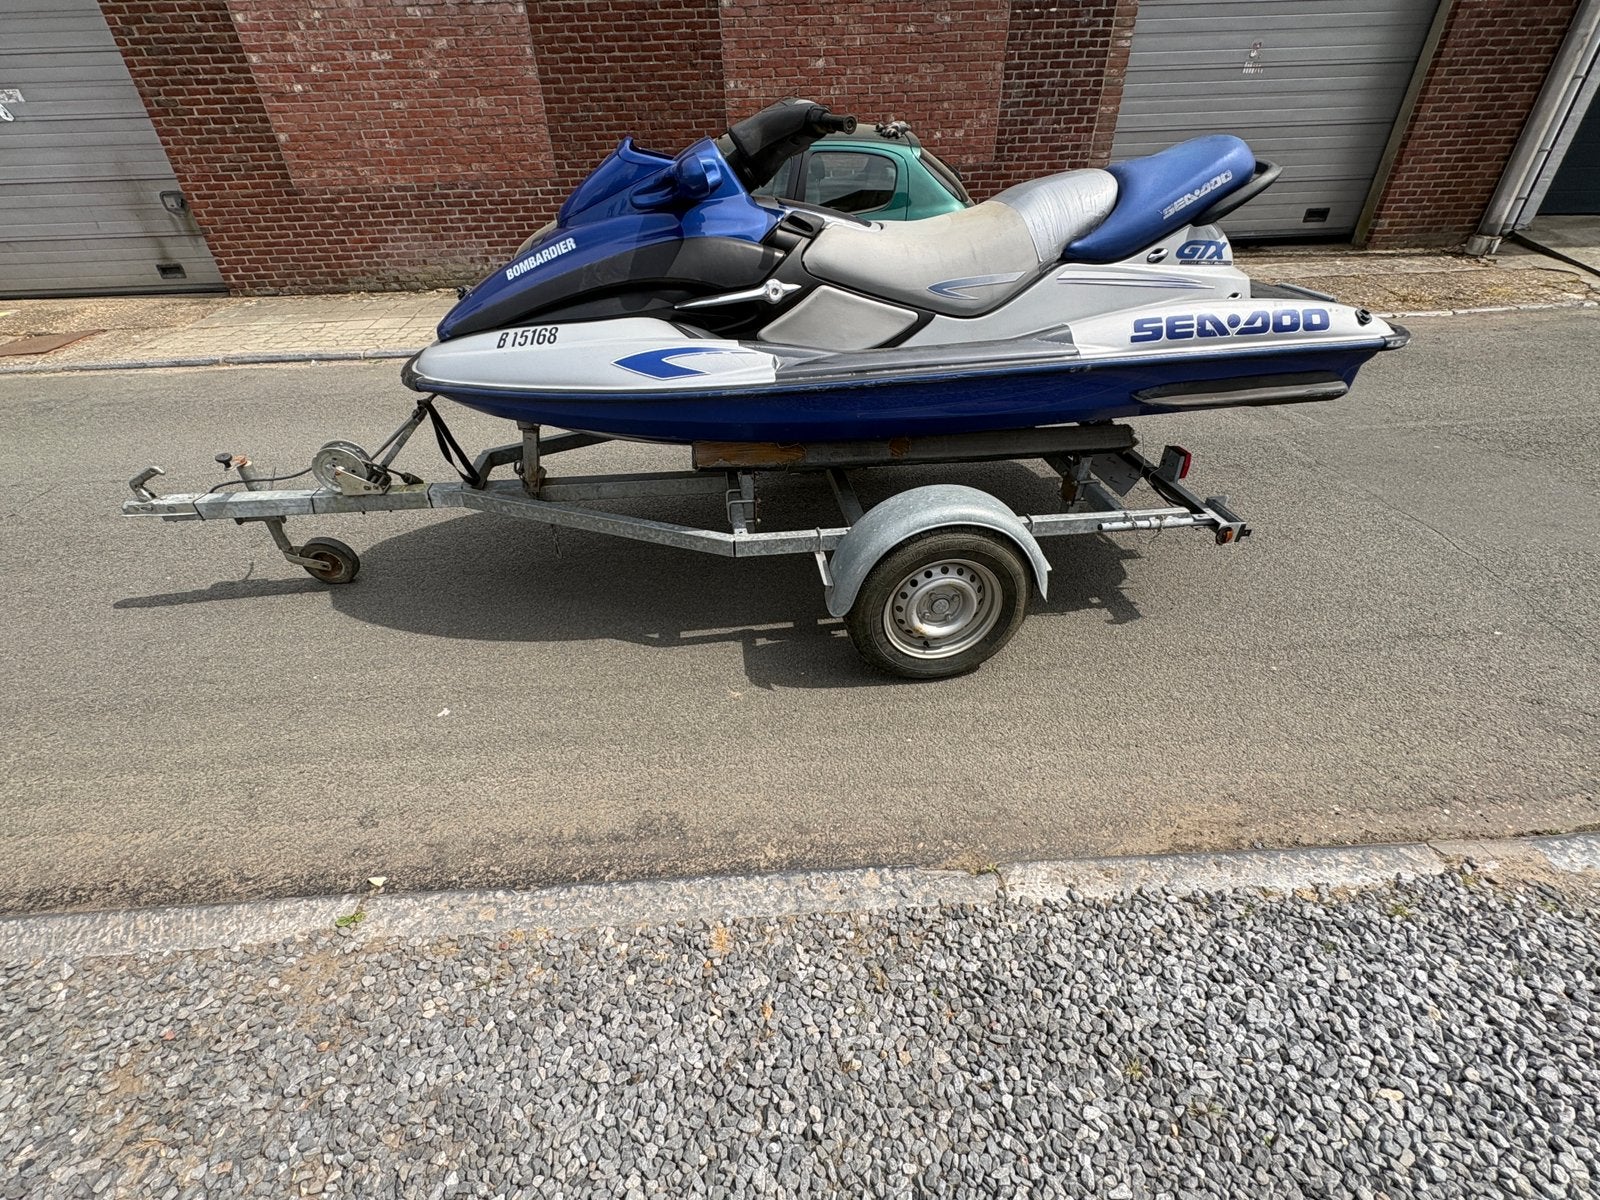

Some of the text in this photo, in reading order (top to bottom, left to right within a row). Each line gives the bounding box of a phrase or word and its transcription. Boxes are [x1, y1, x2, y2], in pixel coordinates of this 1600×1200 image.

[505, 237, 577, 281] BOMBARDIER
[1175, 239, 1228, 260] GTX
[496, 326, 559, 349] B 15168
